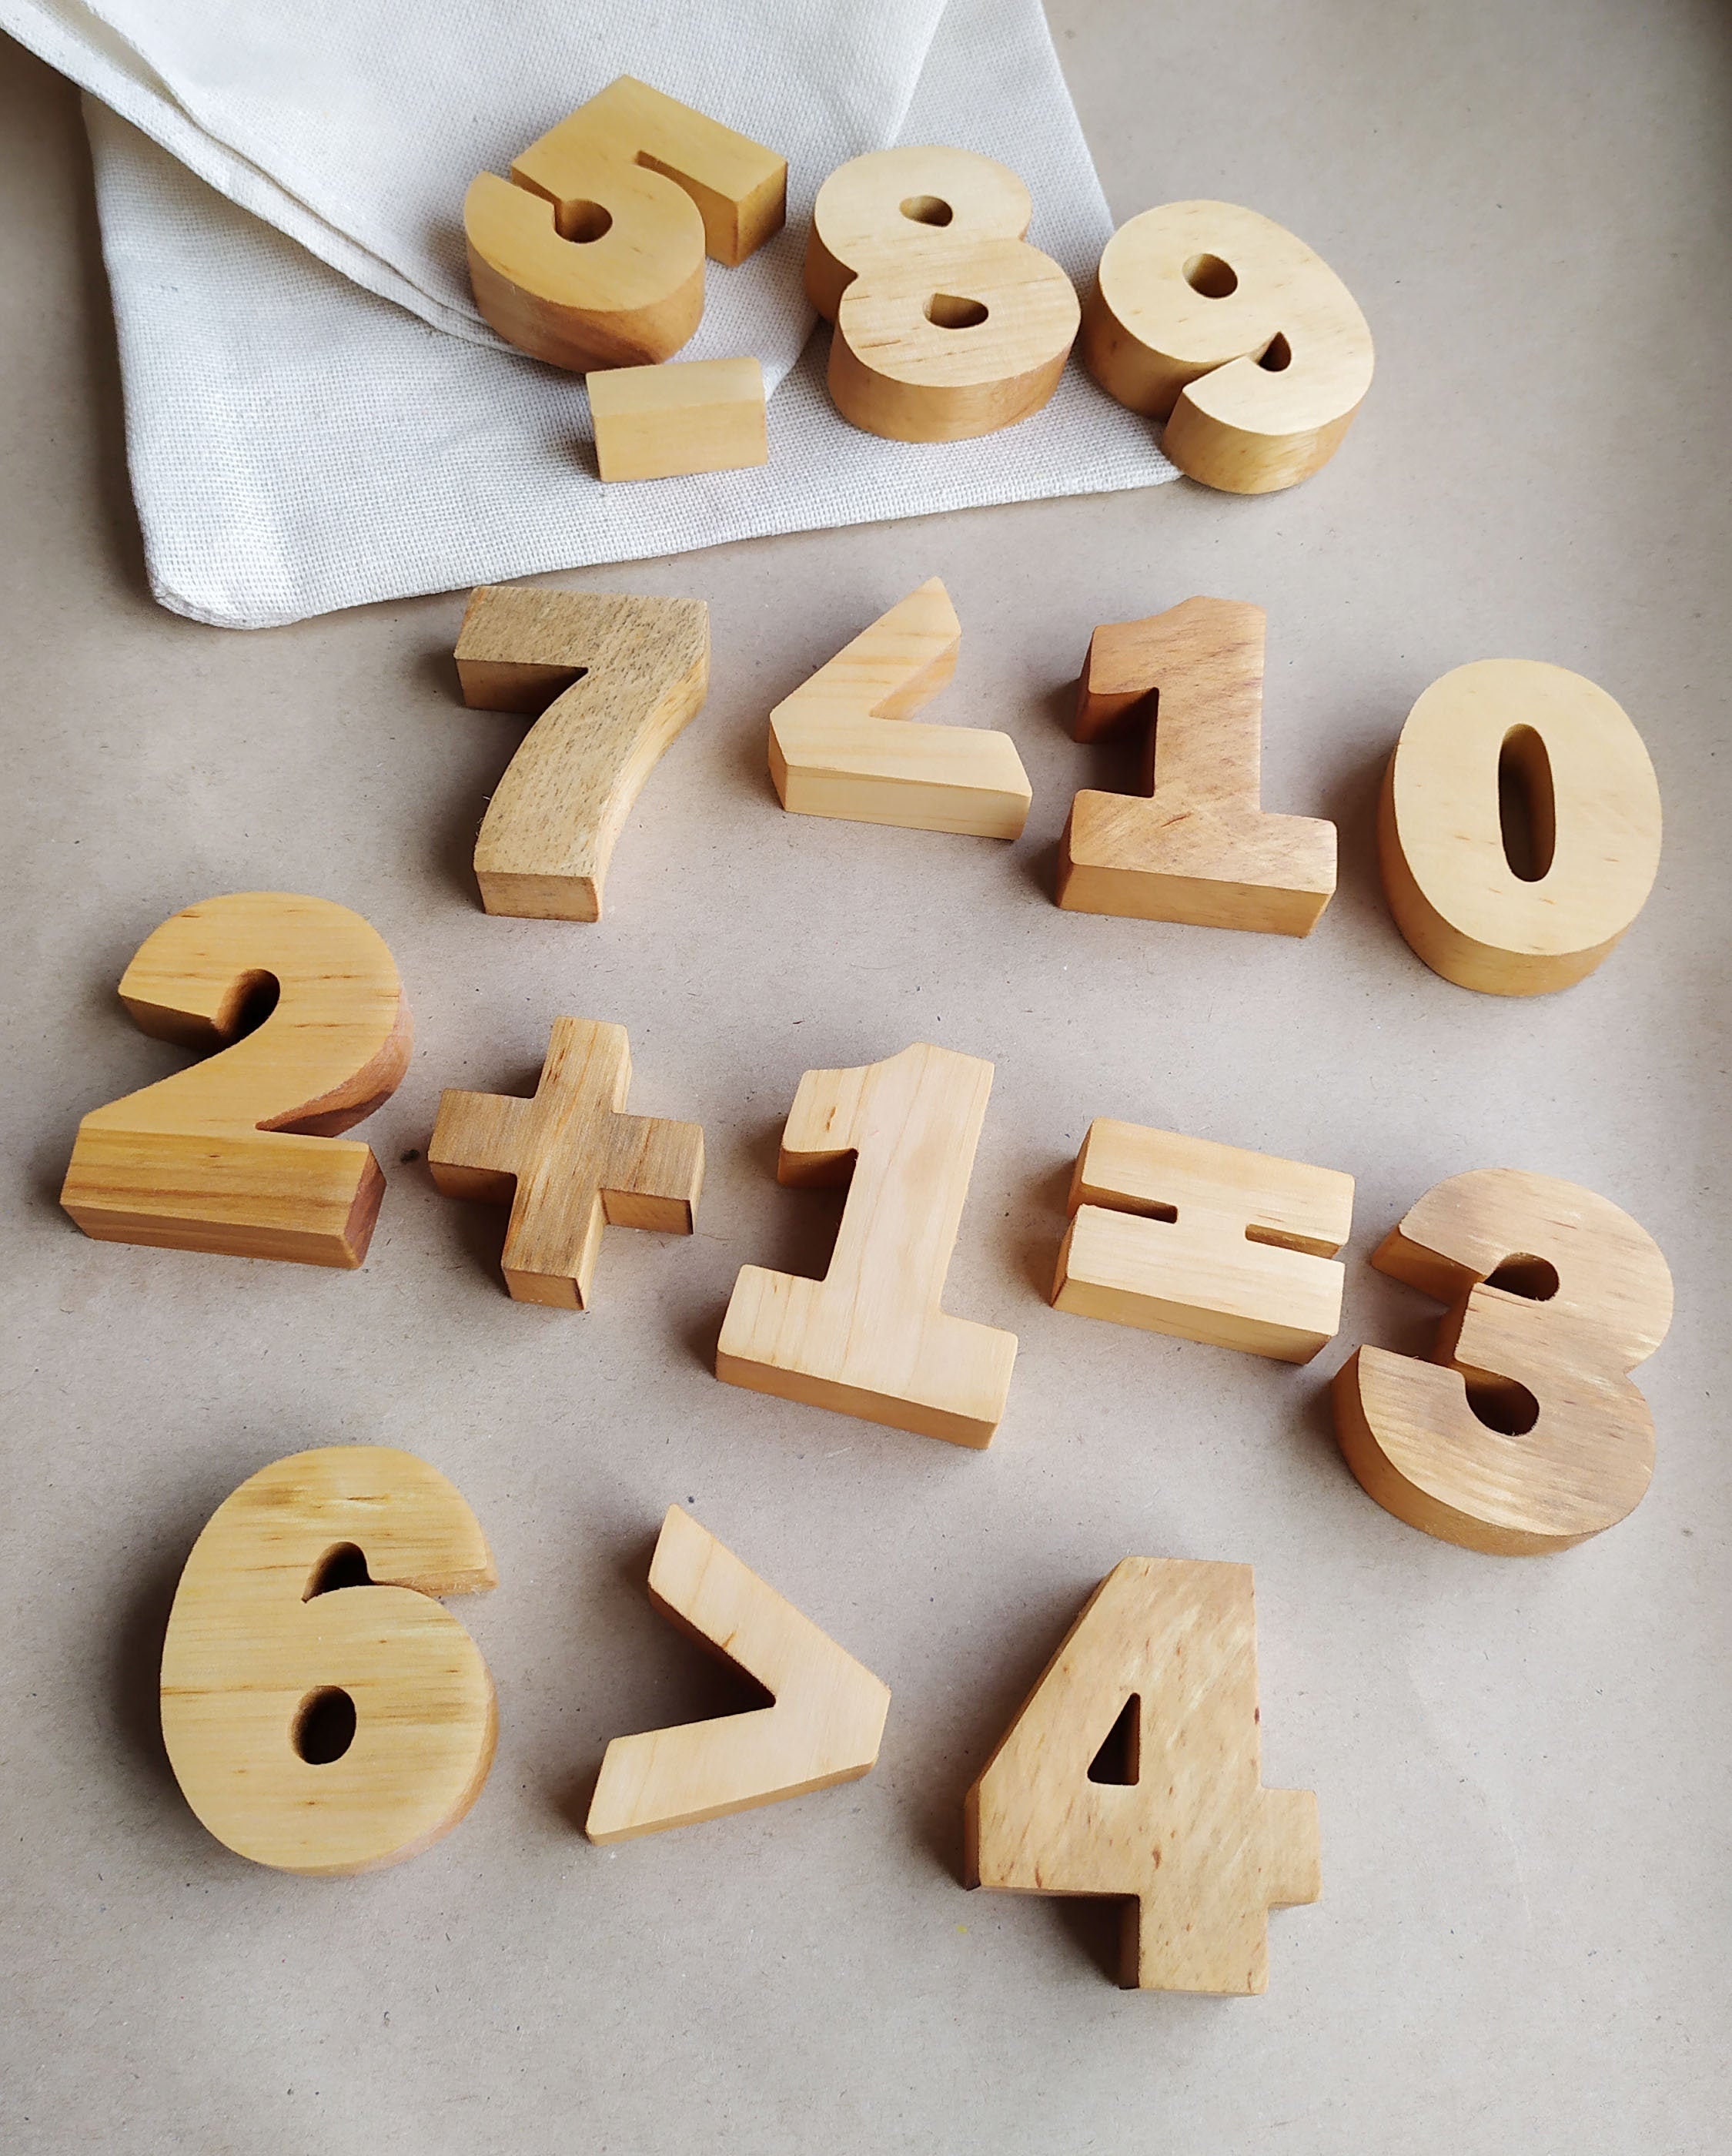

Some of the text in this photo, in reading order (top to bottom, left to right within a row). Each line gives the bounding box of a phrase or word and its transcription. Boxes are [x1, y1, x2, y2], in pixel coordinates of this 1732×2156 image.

[464, 74, 1375, 494] 5 8 9
[453, 584, 711, 922] 7
[60, 890, 412, 1270] 2
[426, 1014, 704, 1311] +
[714, 1042, 1018, 1451] 1
[1333, 1167, 1675, 1557] 3
[159, 1444, 499, 1876] 6
[964, 1555, 1323, 1997] 4
